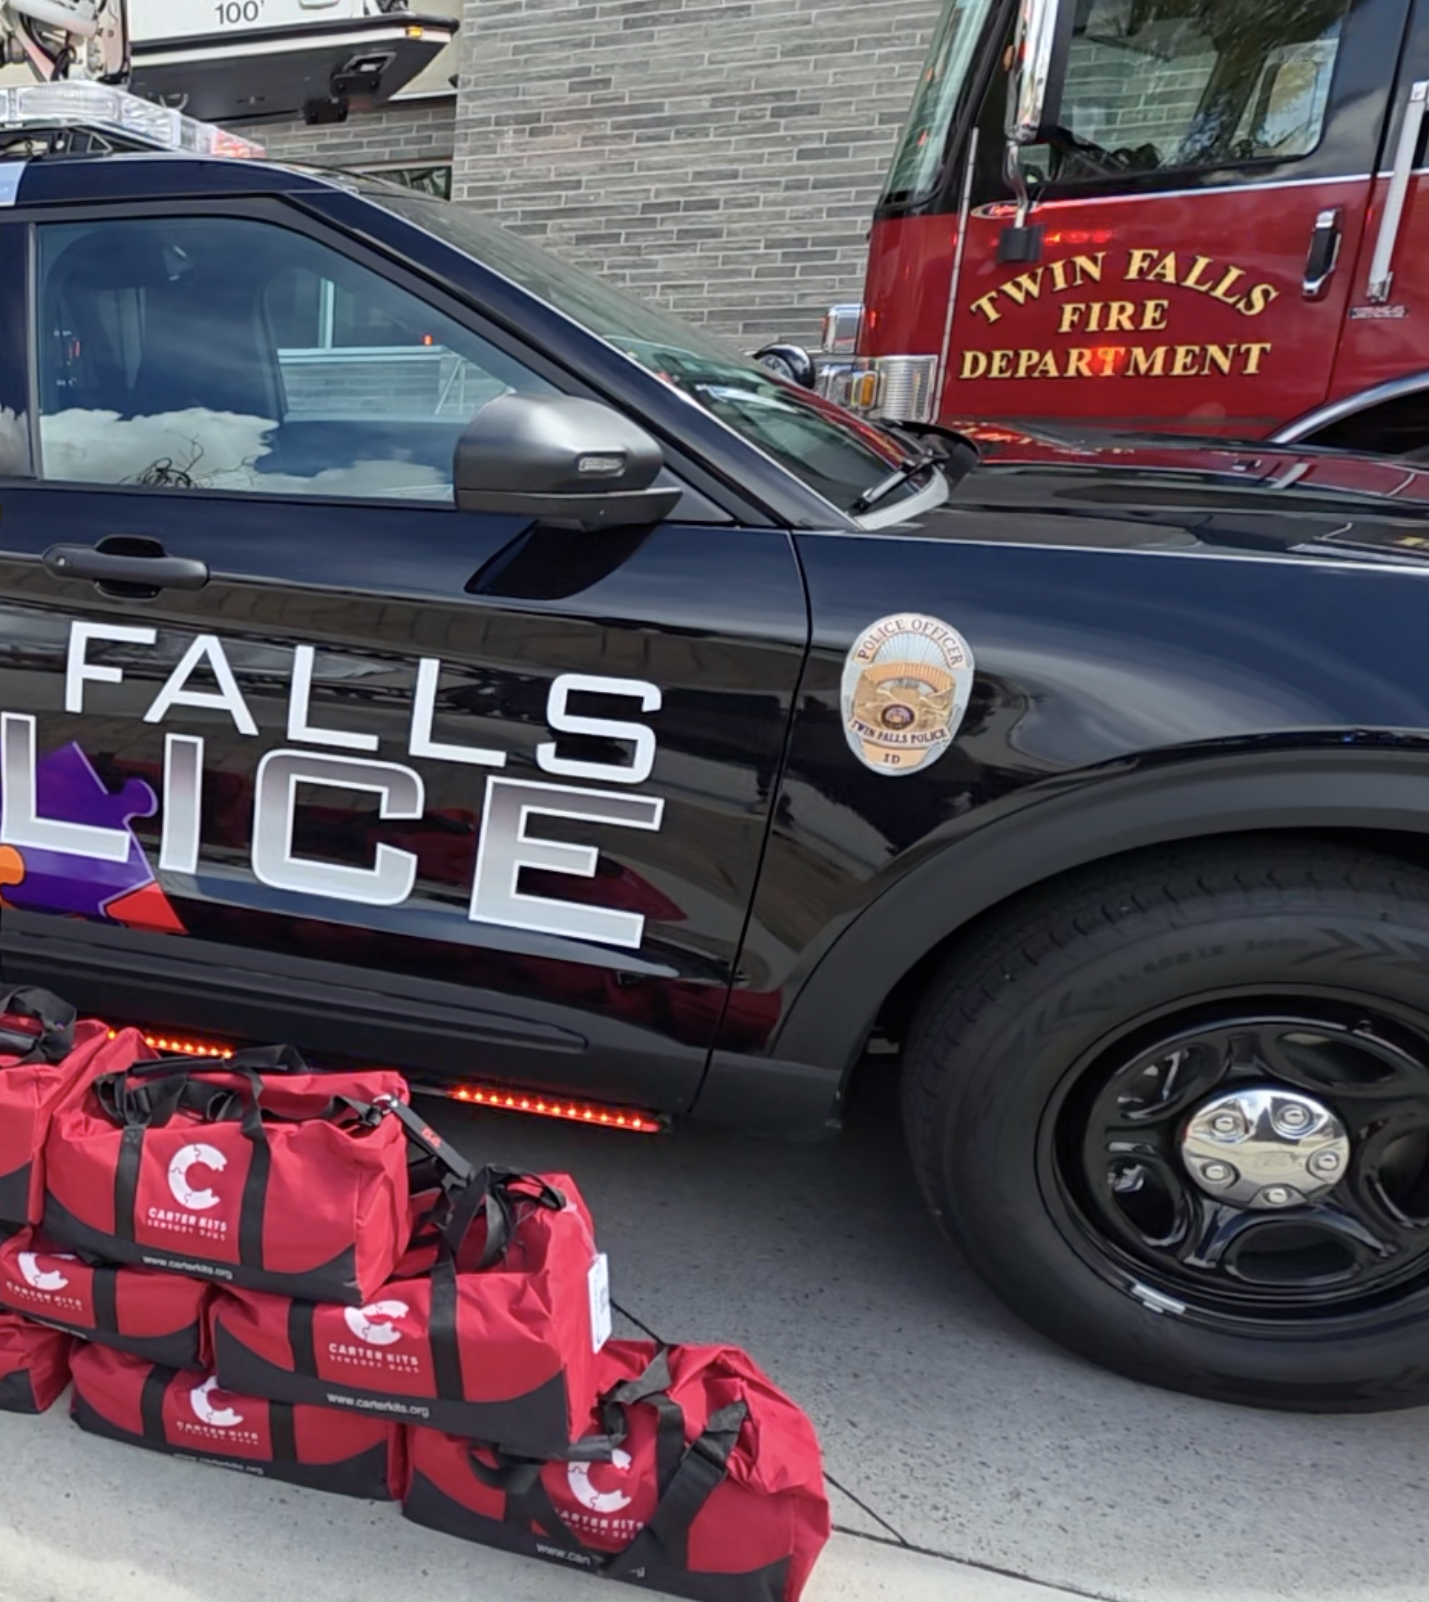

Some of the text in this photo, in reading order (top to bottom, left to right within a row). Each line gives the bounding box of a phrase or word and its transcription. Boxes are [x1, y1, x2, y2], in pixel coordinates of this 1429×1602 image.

[969, 249, 1280, 324] TWIN FALLS
[1058, 300, 1169, 333] FIRE
[959, 343, 1273, 379] DEPARTMENT
[857, 619, 964, 665] POLICE OFFICER
[65, 620, 662, 783] FALLS
[851, 719, 947, 744] TWIN FALLS POLICE
[884, 753, 901, 764] ID
[148, 1206, 227, 1232] CARTER KITS
[142, 1256, 233, 1280] www.carterkits.org
[328, 1342, 419, 1366] CARTER KITS
[326, 1393, 430, 1418] www.carterkits.org
